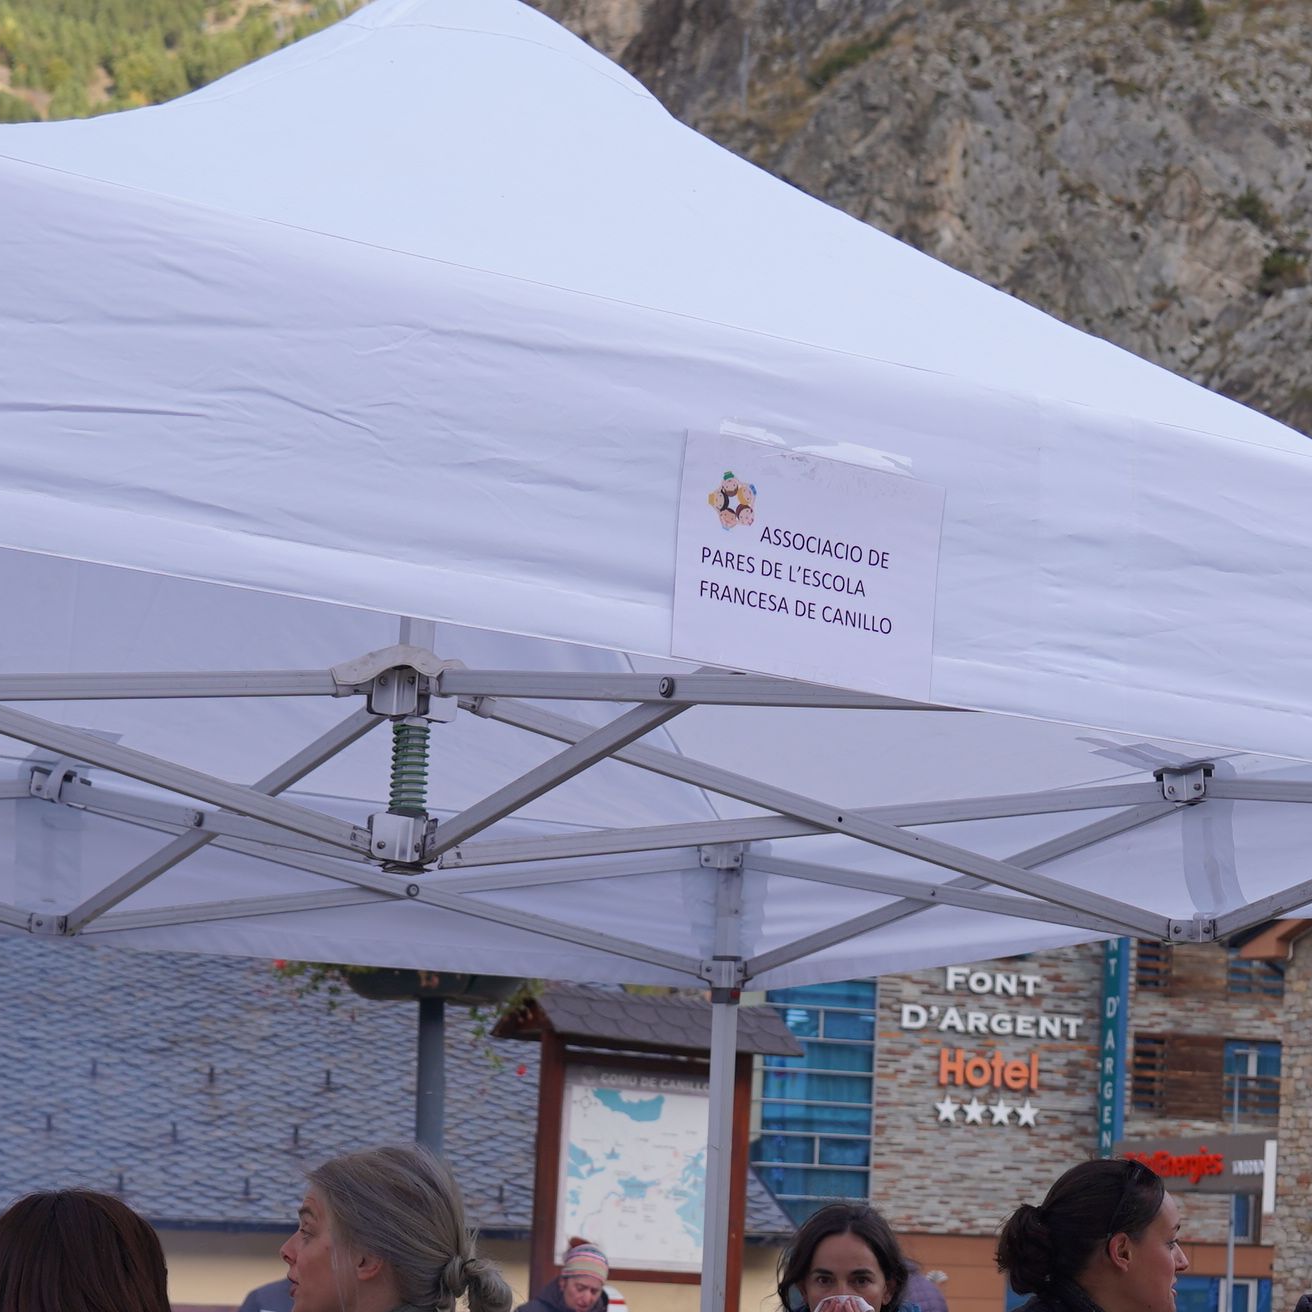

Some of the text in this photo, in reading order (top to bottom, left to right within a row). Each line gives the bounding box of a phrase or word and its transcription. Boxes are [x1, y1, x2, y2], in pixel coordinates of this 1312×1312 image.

[701, 546, 755, 574] PARES
[761, 559, 782, 580] DE
[759, 526, 890, 569] ASSOCIACIO DE
[699, 580, 892, 635] FRANCESA DE CANILLO
[945, 965, 1041, 997] FONT
[939, 1047, 1039, 1091] Hotel
